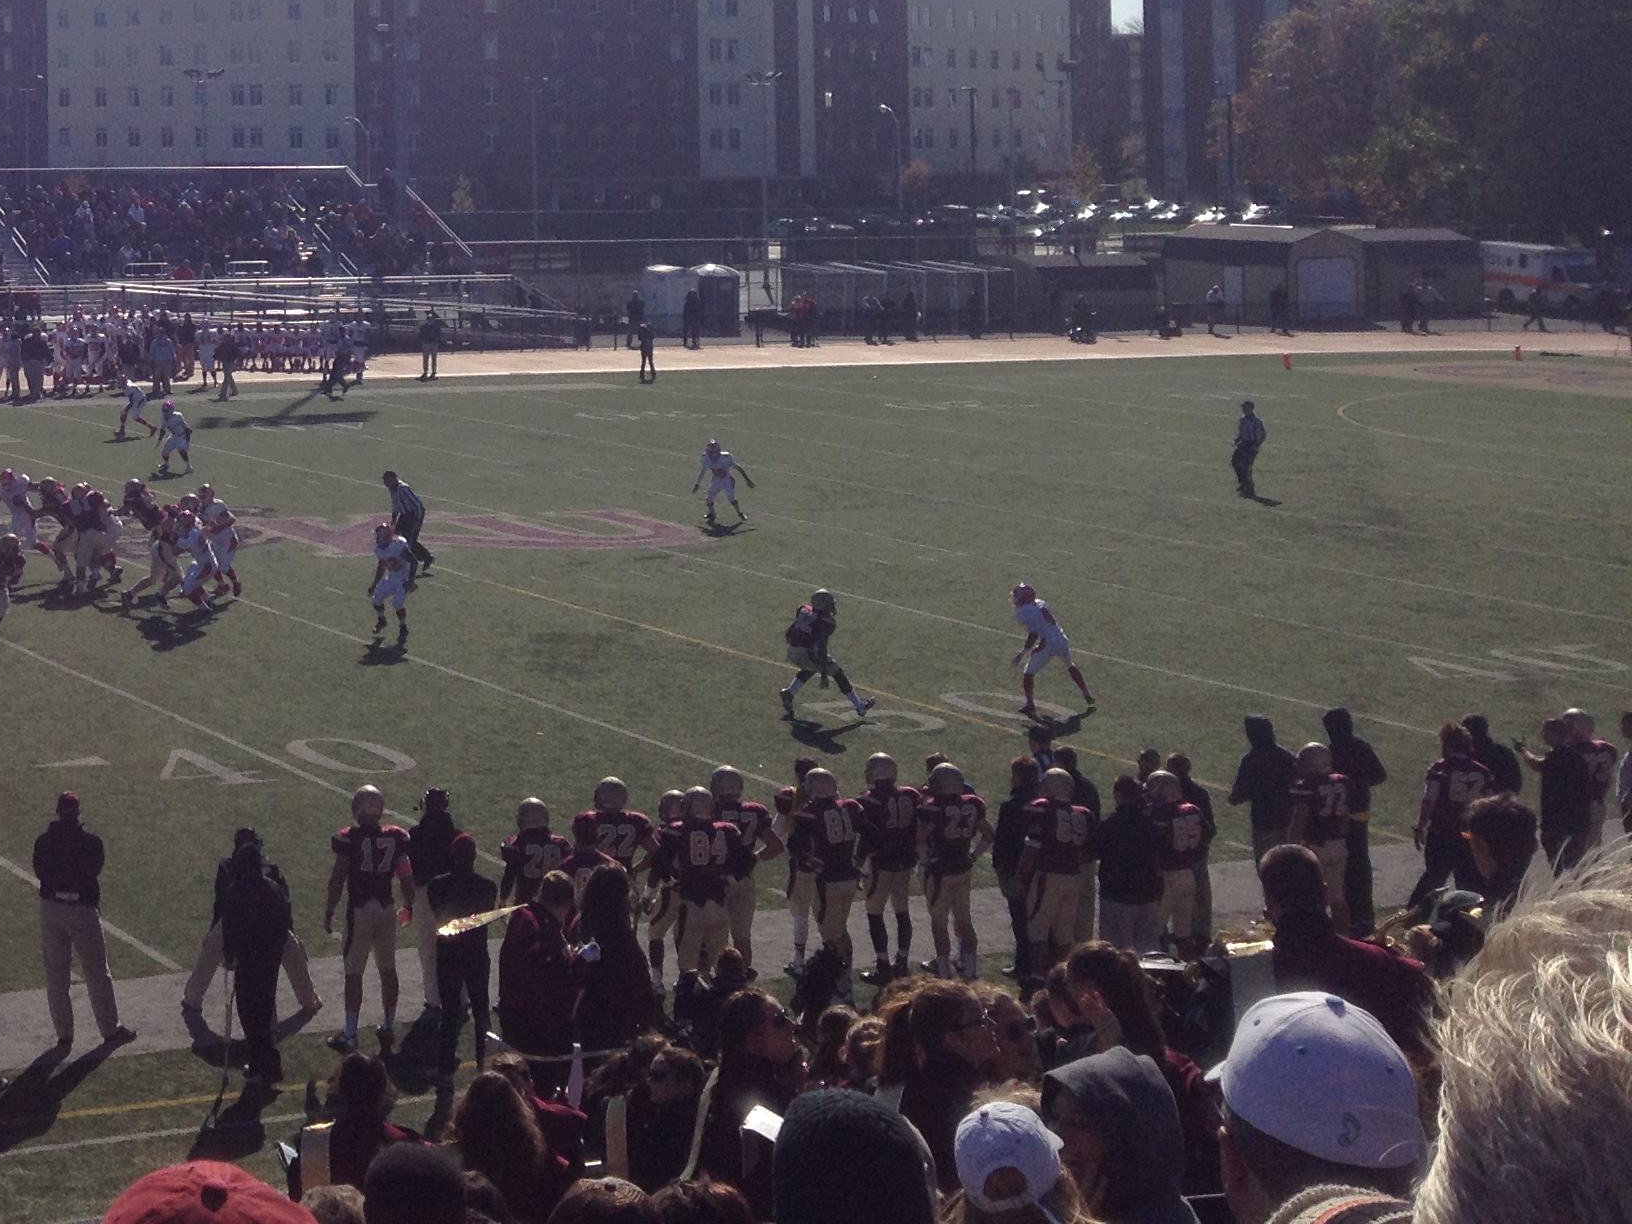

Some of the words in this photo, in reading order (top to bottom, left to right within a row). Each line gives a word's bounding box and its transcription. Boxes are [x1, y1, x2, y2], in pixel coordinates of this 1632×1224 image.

[597, 823, 636, 858] 22
[823, 807, 855, 844] 81
[360, 837, 396, 873] 17
[689, 830, 729, 866] 84
